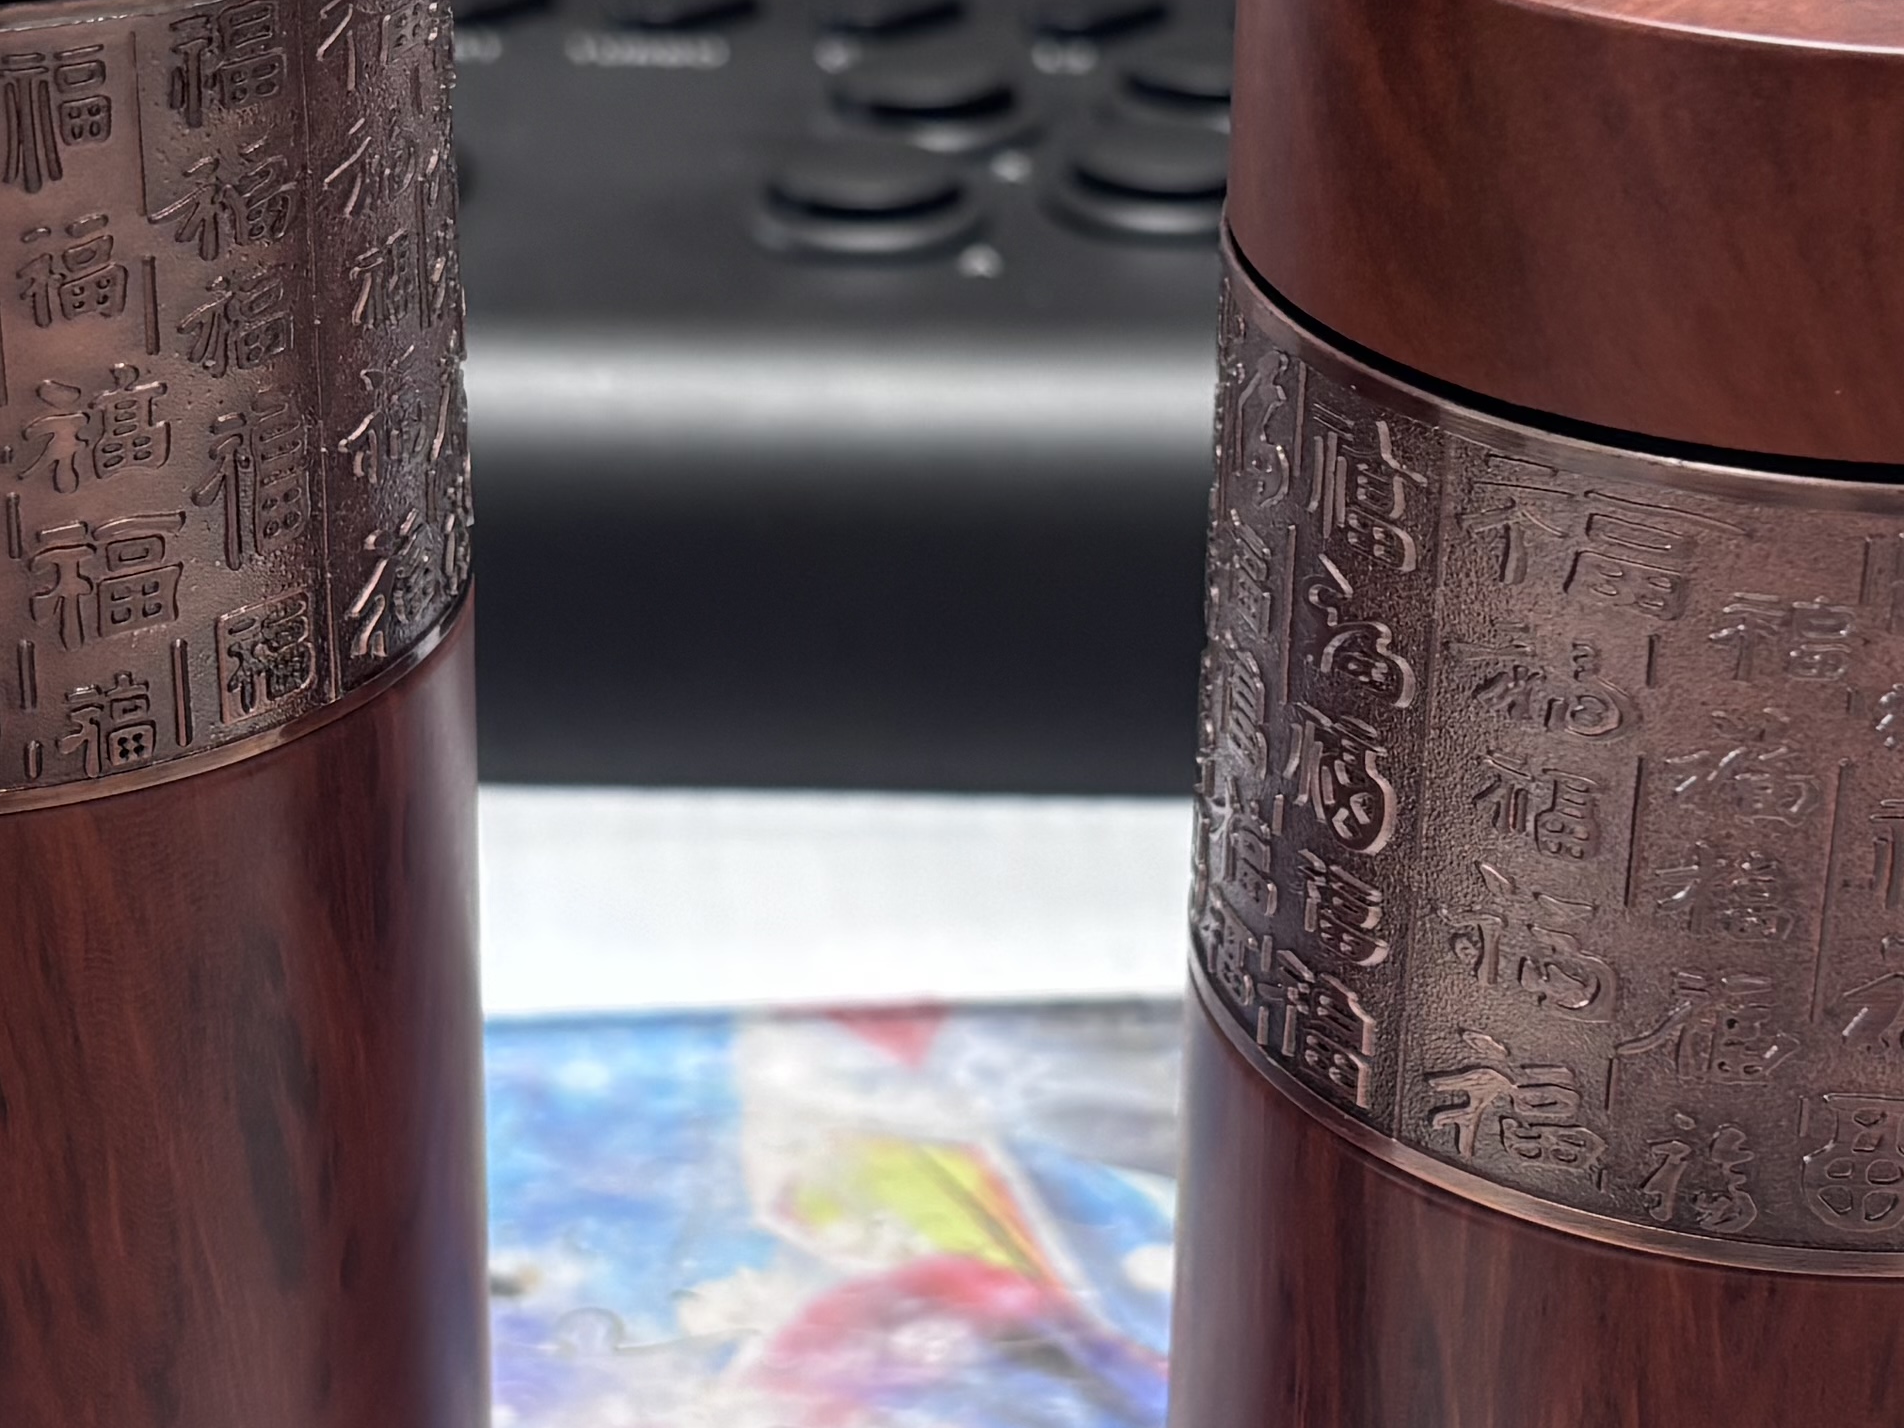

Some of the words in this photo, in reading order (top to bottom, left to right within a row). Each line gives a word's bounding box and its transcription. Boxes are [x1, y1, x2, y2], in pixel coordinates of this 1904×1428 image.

[18, 214, 128, 327] 福
[20, 364, 172, 493] 福
[30, 511, 187, 650] 福
[59, 673, 158, 778] 福
